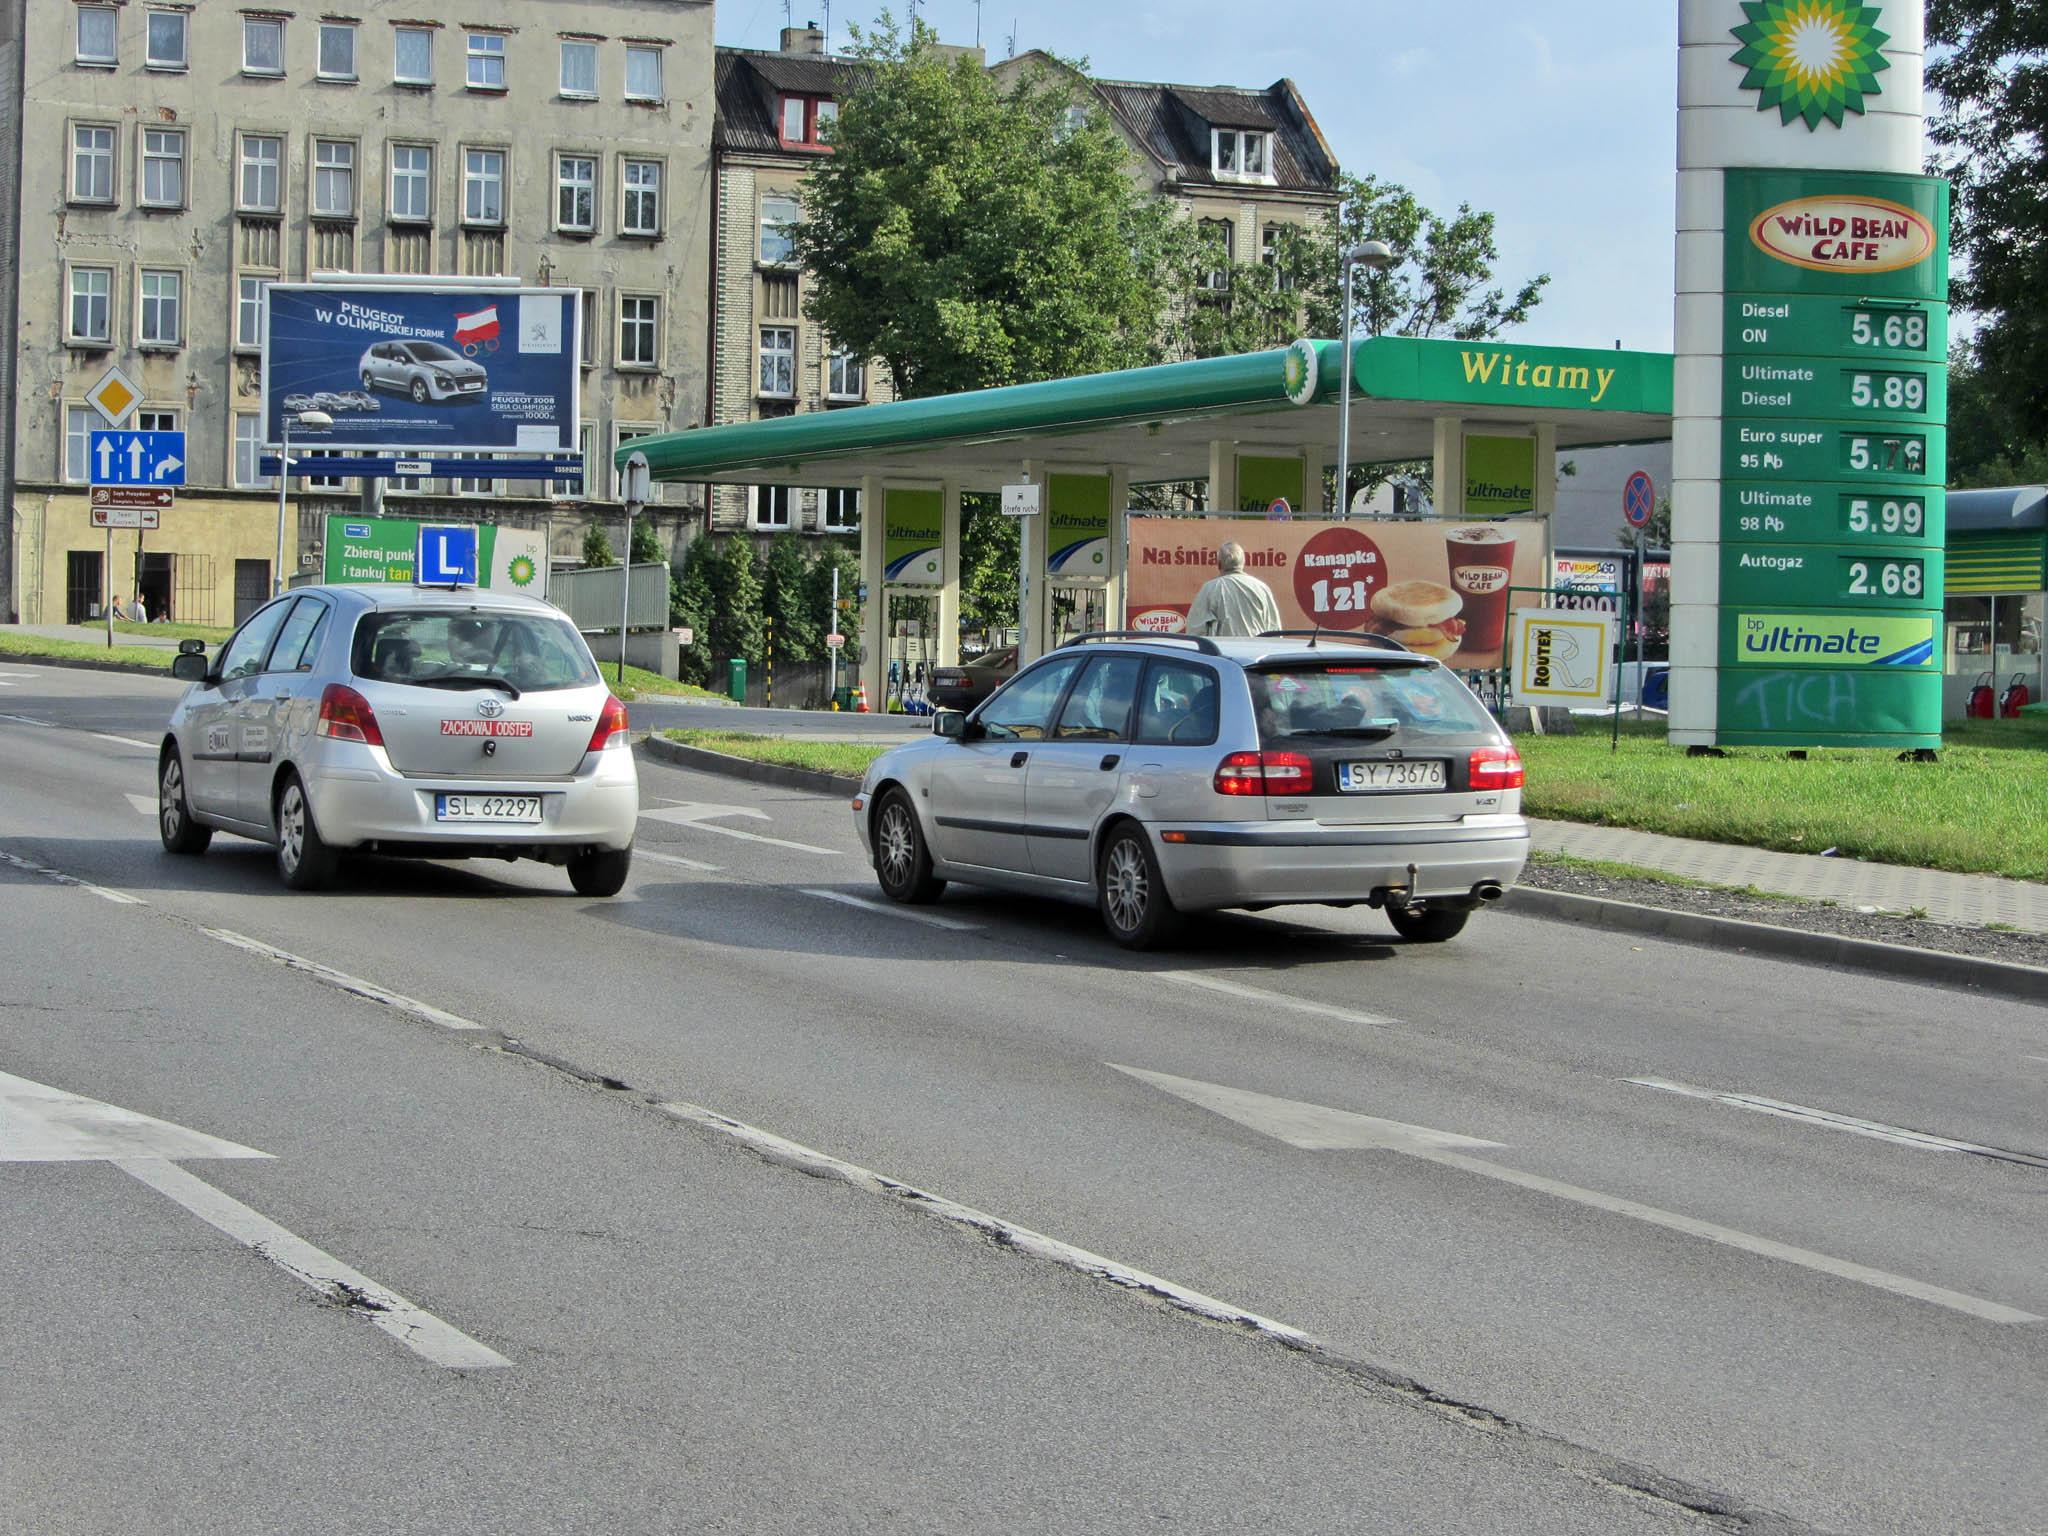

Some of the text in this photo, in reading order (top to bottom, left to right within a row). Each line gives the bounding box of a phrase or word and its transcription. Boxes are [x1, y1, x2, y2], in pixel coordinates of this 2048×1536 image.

[1851, 216, 1909, 239] BEAN
[1811, 238, 1879, 261] CAFE
[341, 301, 405, 325] PEUGEOT
[315, 308, 445, 338] W OLIMPIJSKIEJ FORMIE
[1742, 303, 1924, 348] Diesel 5.68
[1742, 329, 1768, 343] ON
[1461, 351, 1616, 402] Witamy
[1742, 366, 1924, 409] Ultimate 5.89
[491, 396, 531, 404] PEUGEOT
[1742, 391, 1791, 407] Diesel
[1740, 428, 1775, 444] Euro
[1780, 431, 1823, 446] super
[1740, 454, 1758, 468] 95
[1467, 482, 1532, 499] ultimate
[1003, 504, 1038, 513] Strefa ruchu
[1740, 491, 1922, 533] Ultimate 5.99
[1050, 512, 1108, 527] ultimate
[1740, 516, 1759, 531] 98
[887, 525, 941, 538] ultimate
[344, 544, 415, 566] Zbieraj punk
[439, 536, 463, 574] L
[527, 544, 537, 554] bp
[1142, 545, 1287, 567] Na śniaanie
[1304, 550, 1377, 567] Kanapka
[1557, 561, 1574, 572] RTV
[342, 564, 346, 576] i
[349, 567, 386, 583] tankuj
[1332, 568, 1349, 579] za
[1482, 571, 1504, 582] BEAN
[1739, 553, 1922, 595] Autogaz 2.68
[1467, 581, 1493, 590] CAFE
[1160, 616, 1178, 625] BEAN
[1747, 617, 1764, 631] bp
[1746, 626, 1880, 655] ultimate
[1534, 628, 1552, 688] ROUTEX
[442, 719, 532, 737] ZACHOWAJ ODSTEP
[1353, 763, 1440, 785] SY 73676
[450, 798, 539, 817] SL 62297
